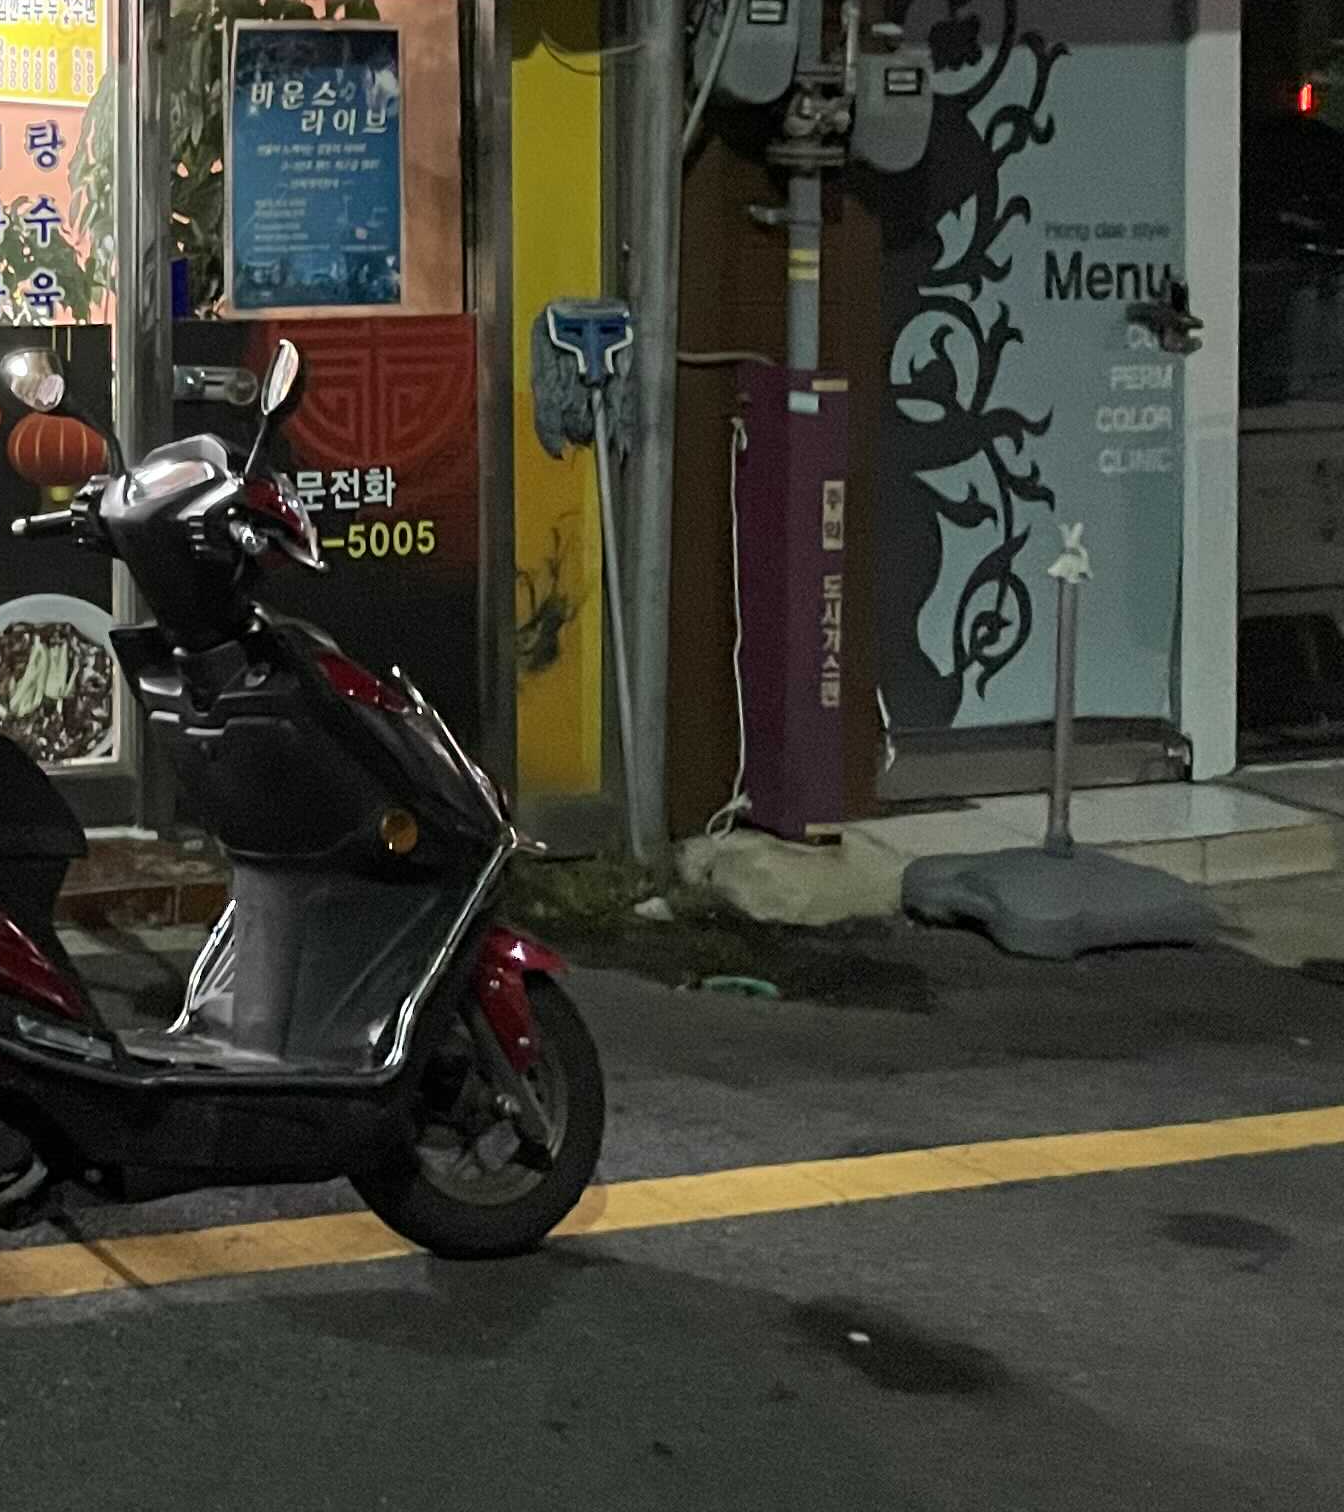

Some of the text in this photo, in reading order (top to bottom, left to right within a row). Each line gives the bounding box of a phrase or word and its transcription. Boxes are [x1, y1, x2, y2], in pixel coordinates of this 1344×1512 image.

[300, 107, 388, 136] 라이브
[24, 126, 63, 319] 탕수육
[1045, 249, 1171, 301] Menu
[1097, 406, 1172, 432] COLOR
[296, 466, 396, 512] 문전화
[321, 520, 436, 558] -5005
